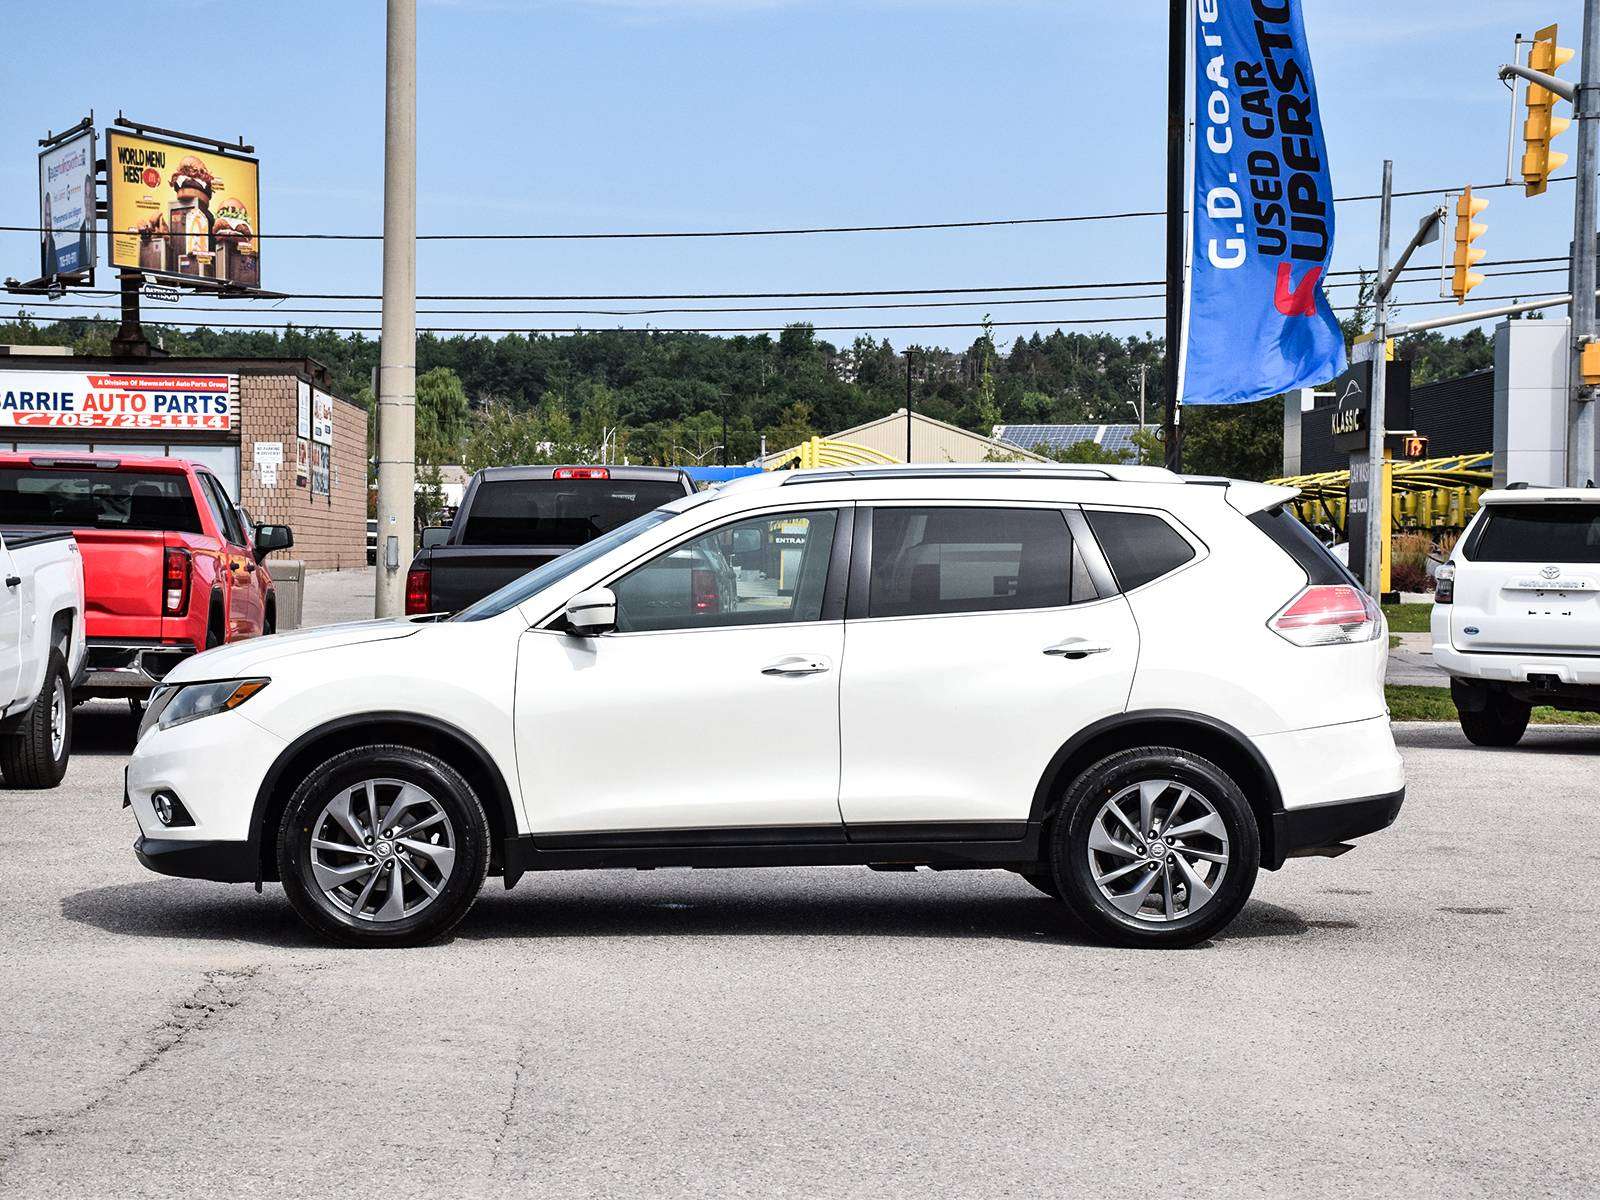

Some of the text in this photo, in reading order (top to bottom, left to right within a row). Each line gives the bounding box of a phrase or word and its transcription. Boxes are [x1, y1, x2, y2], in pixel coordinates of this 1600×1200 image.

[118, 146, 166, 169] WORLD MENU
[1233, 60, 1288, 256] USED CAR
[123, 165, 144, 184] HEIST
[1207, 171, 1248, 270] G.D.
[208, 381, 228, 389] Group
[0, 391, 228, 414] ARRIE AUTO PARTS
[47, 413, 225, 428] 705-725-1114
[1331, 408, 1360, 435] KLASSIC
